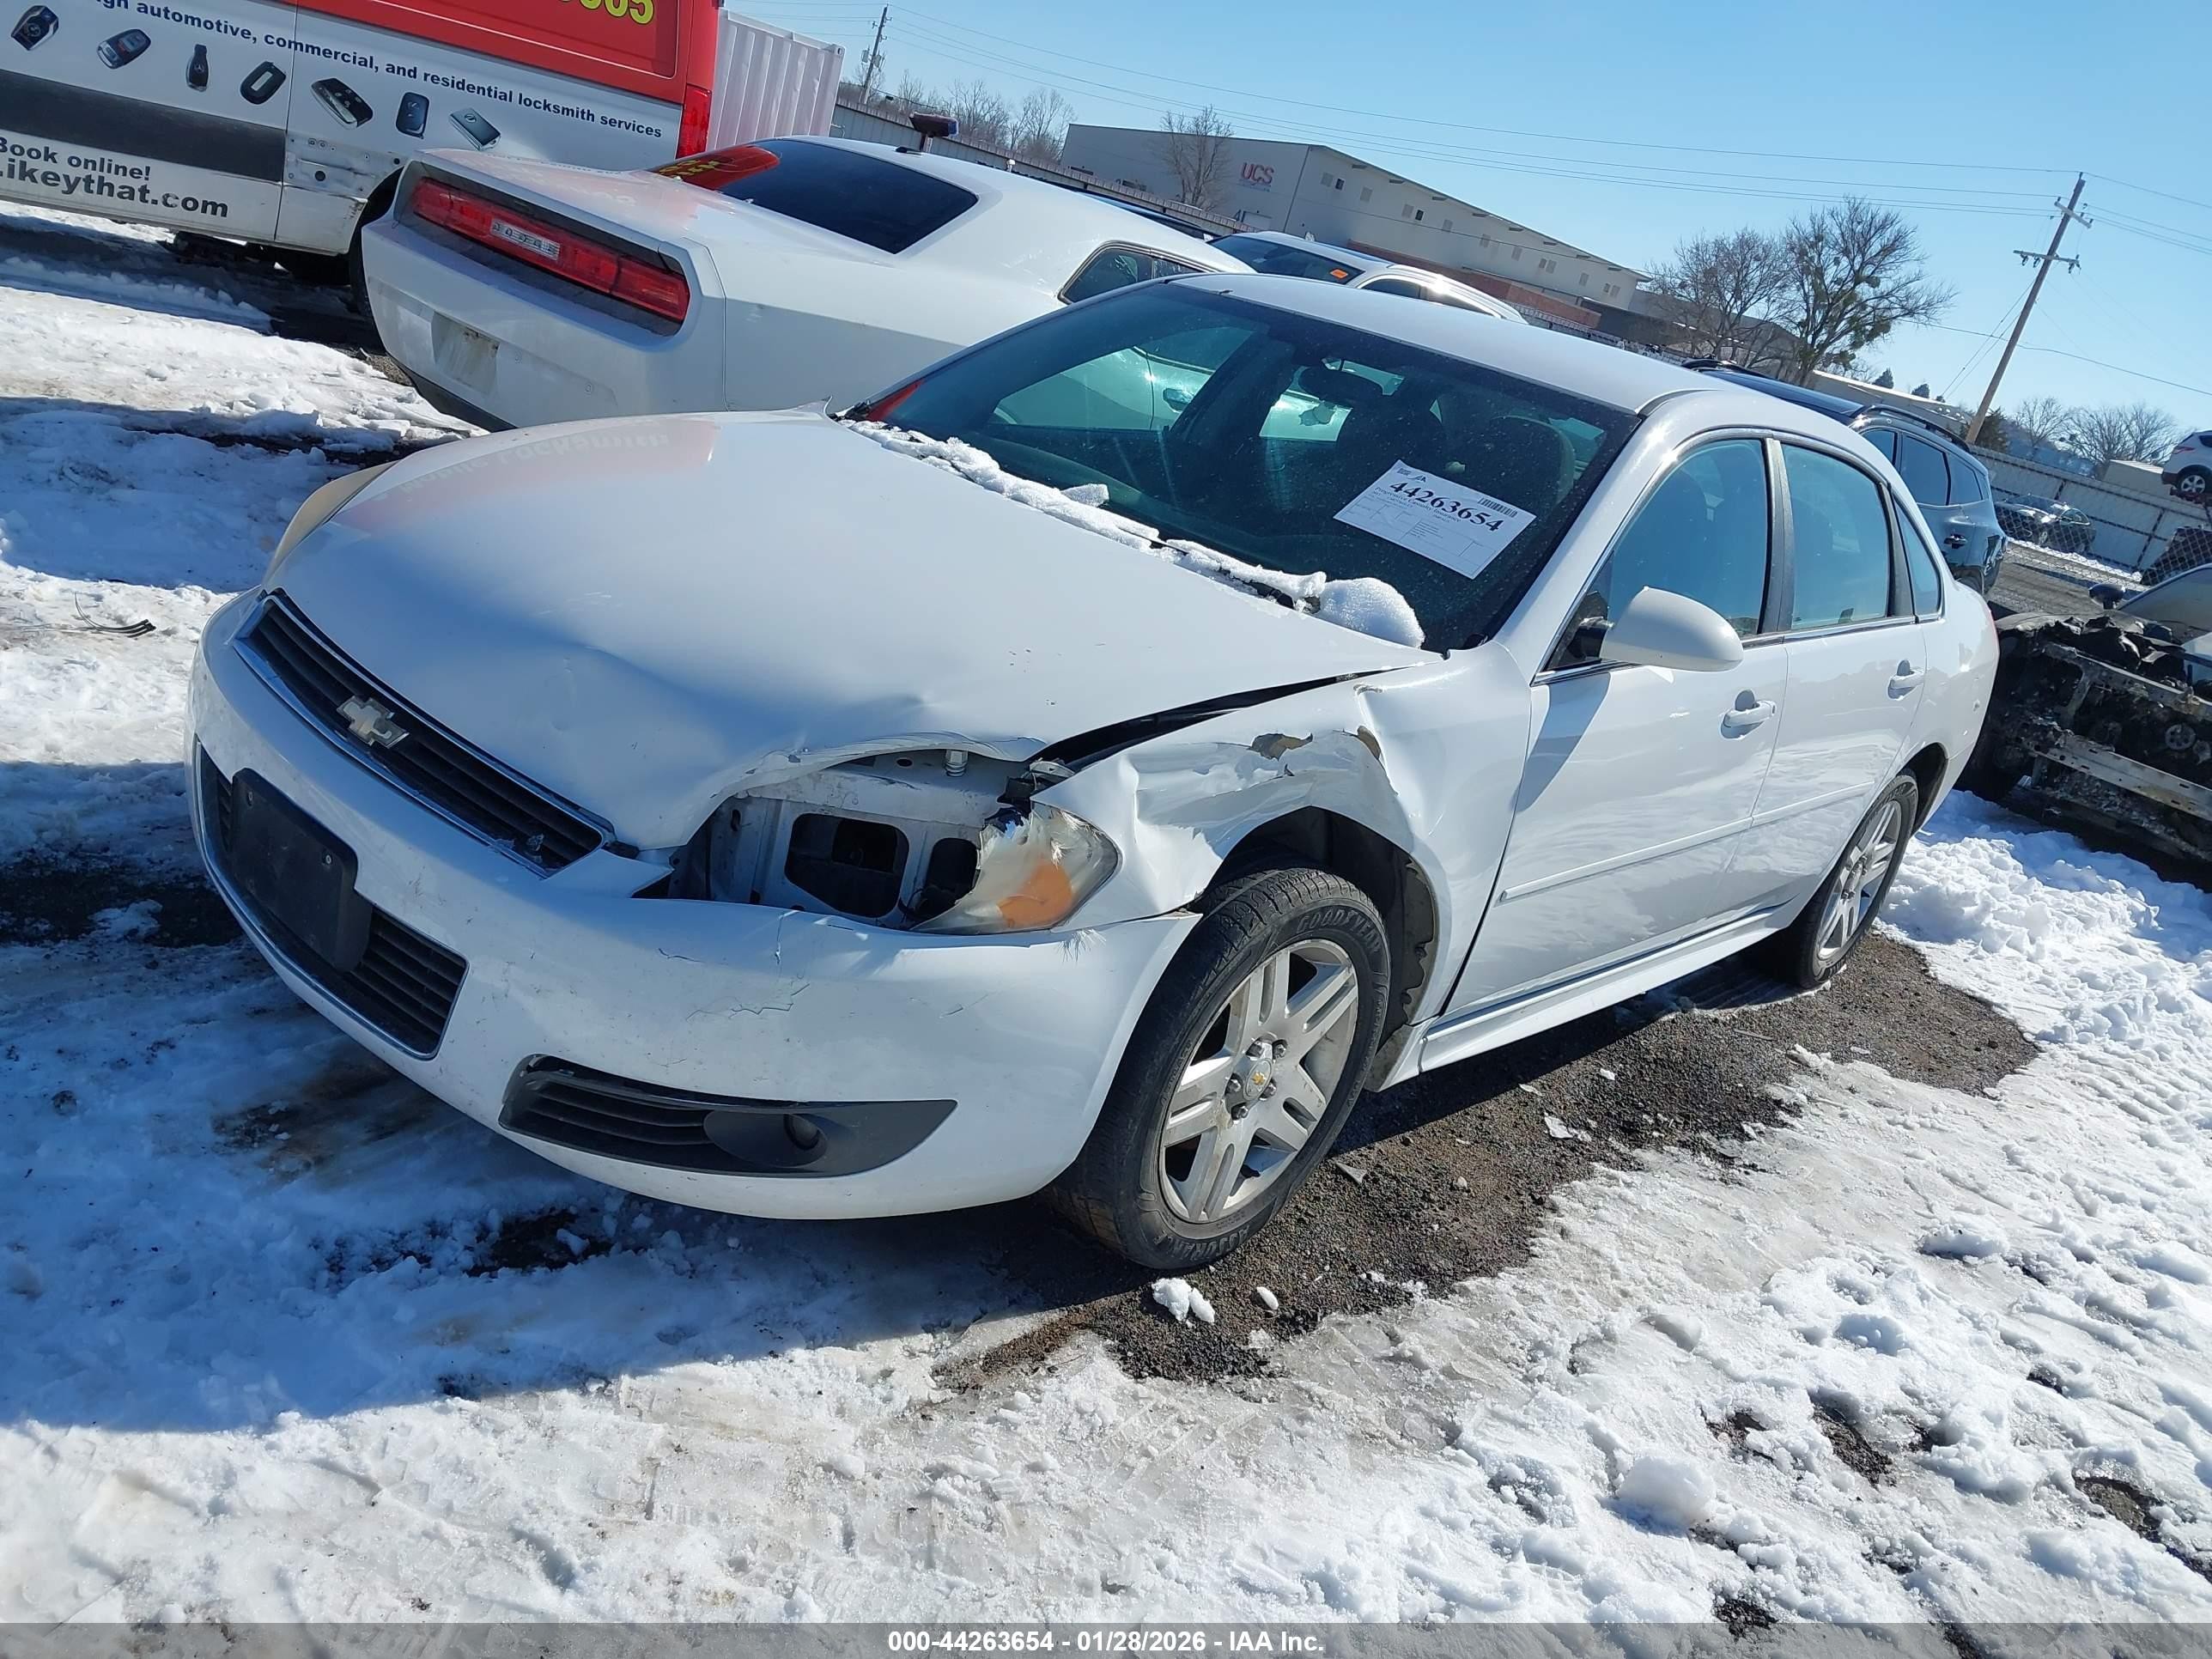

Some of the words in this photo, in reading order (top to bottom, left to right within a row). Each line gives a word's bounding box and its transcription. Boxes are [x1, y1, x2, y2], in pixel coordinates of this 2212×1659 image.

[137, 3, 258, 44] automotive,
[264, 33, 379, 72] commercial,
[386, 60, 417, 79] and
[422, 71, 513, 103] residential
[518, 93, 595, 122] locksmith
[599, 114, 662, 137] services
[0, 158, 228, 218] ikeythat.com
[67, 155, 151, 181] online!
[1241, 162, 1274, 185] UCS
[1389, 482, 1504, 532] 44263654
